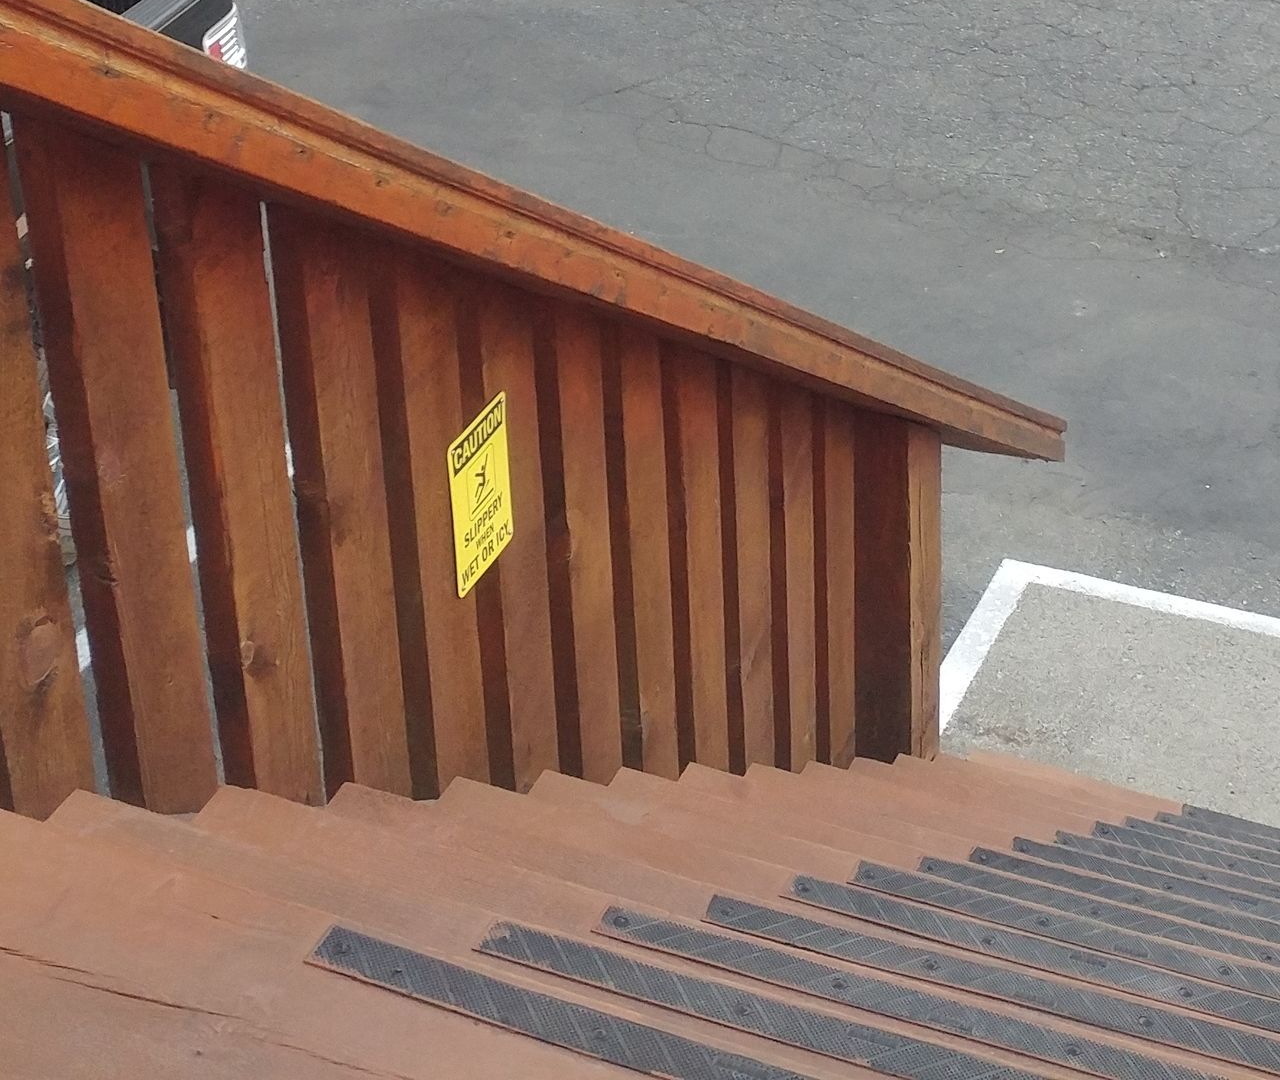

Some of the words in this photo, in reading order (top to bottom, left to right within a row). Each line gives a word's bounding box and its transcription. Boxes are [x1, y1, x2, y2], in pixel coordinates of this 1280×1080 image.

[454, 403, 502, 469] CAUTION
[464, 492, 503, 549] SLIPPERY
[476, 522, 495, 550] WHEN
[461, 554, 480, 586] WET
[481, 539, 495, 562] OR
[496, 519, 509, 546] ICY
